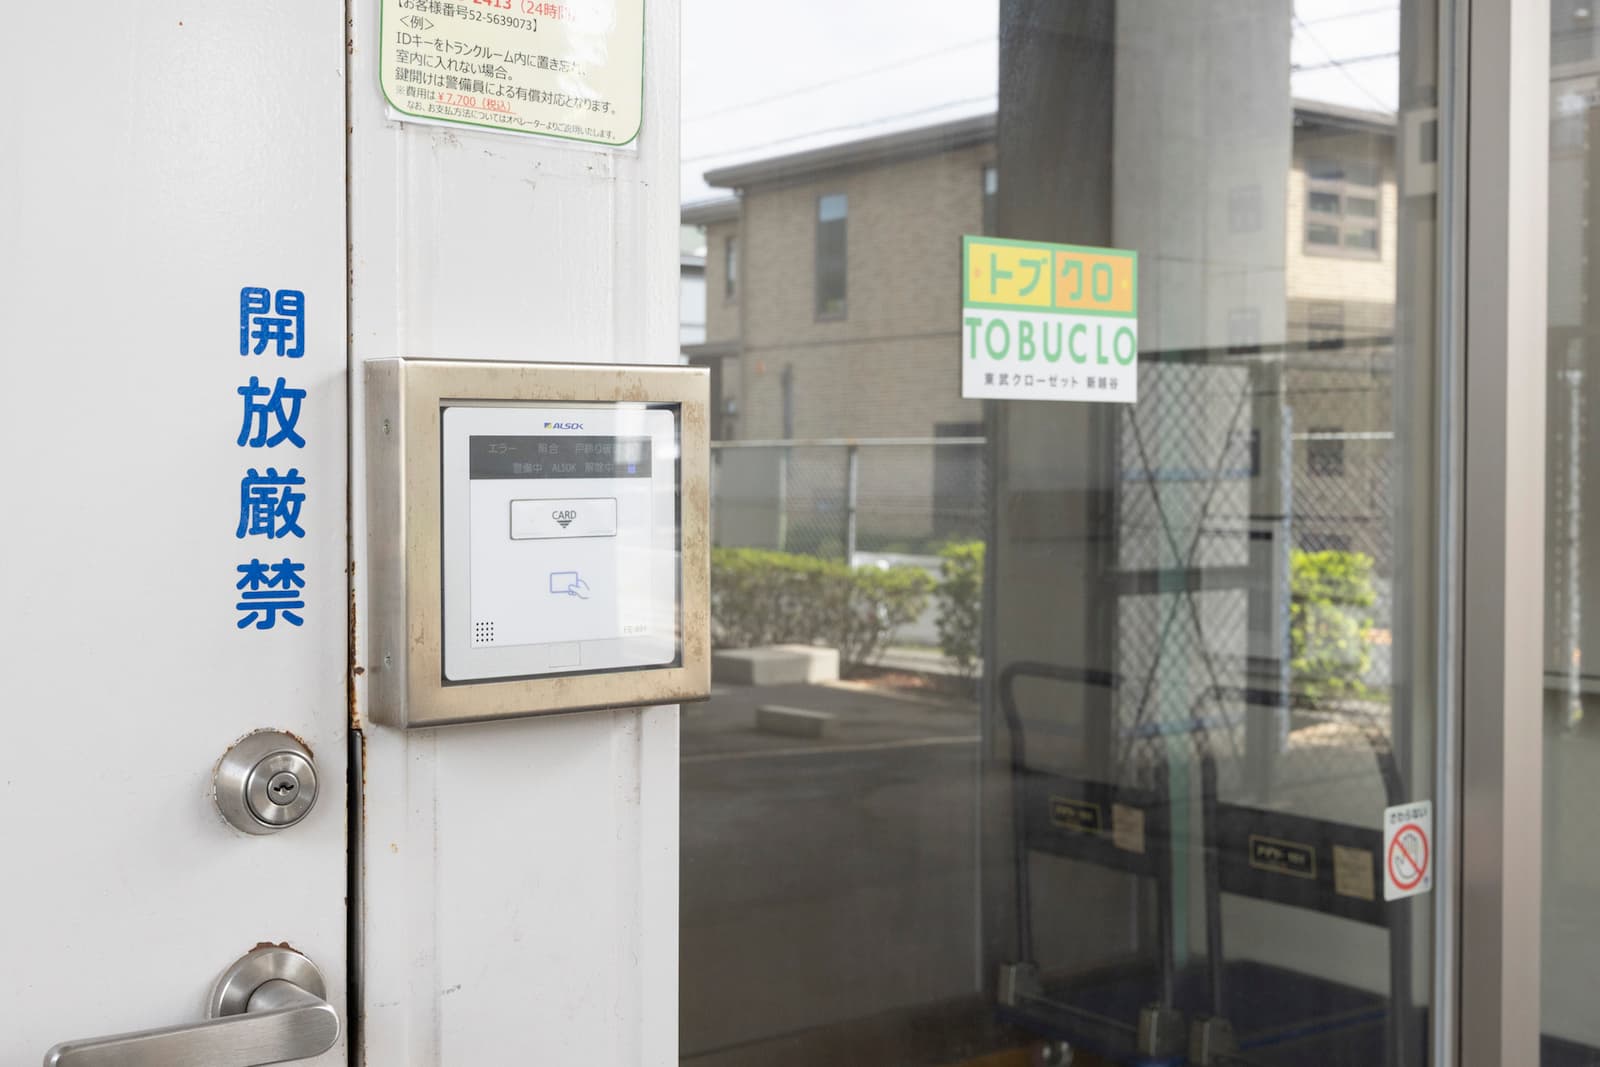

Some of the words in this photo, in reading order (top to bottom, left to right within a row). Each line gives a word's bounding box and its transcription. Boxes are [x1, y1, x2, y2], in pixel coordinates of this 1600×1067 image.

[395, 49, 513, 81] 室内に入れない場合。
[964, 317, 1137, 366] TOBUCLO
[984, 373, 1079, 388] 東武クローゼット
[553, 422, 584, 430] ALSOK
[487, 443, 517, 455] エラー
[235, 286, 307, 630] 開放厳禁
[552, 511, 577, 520] CARD
